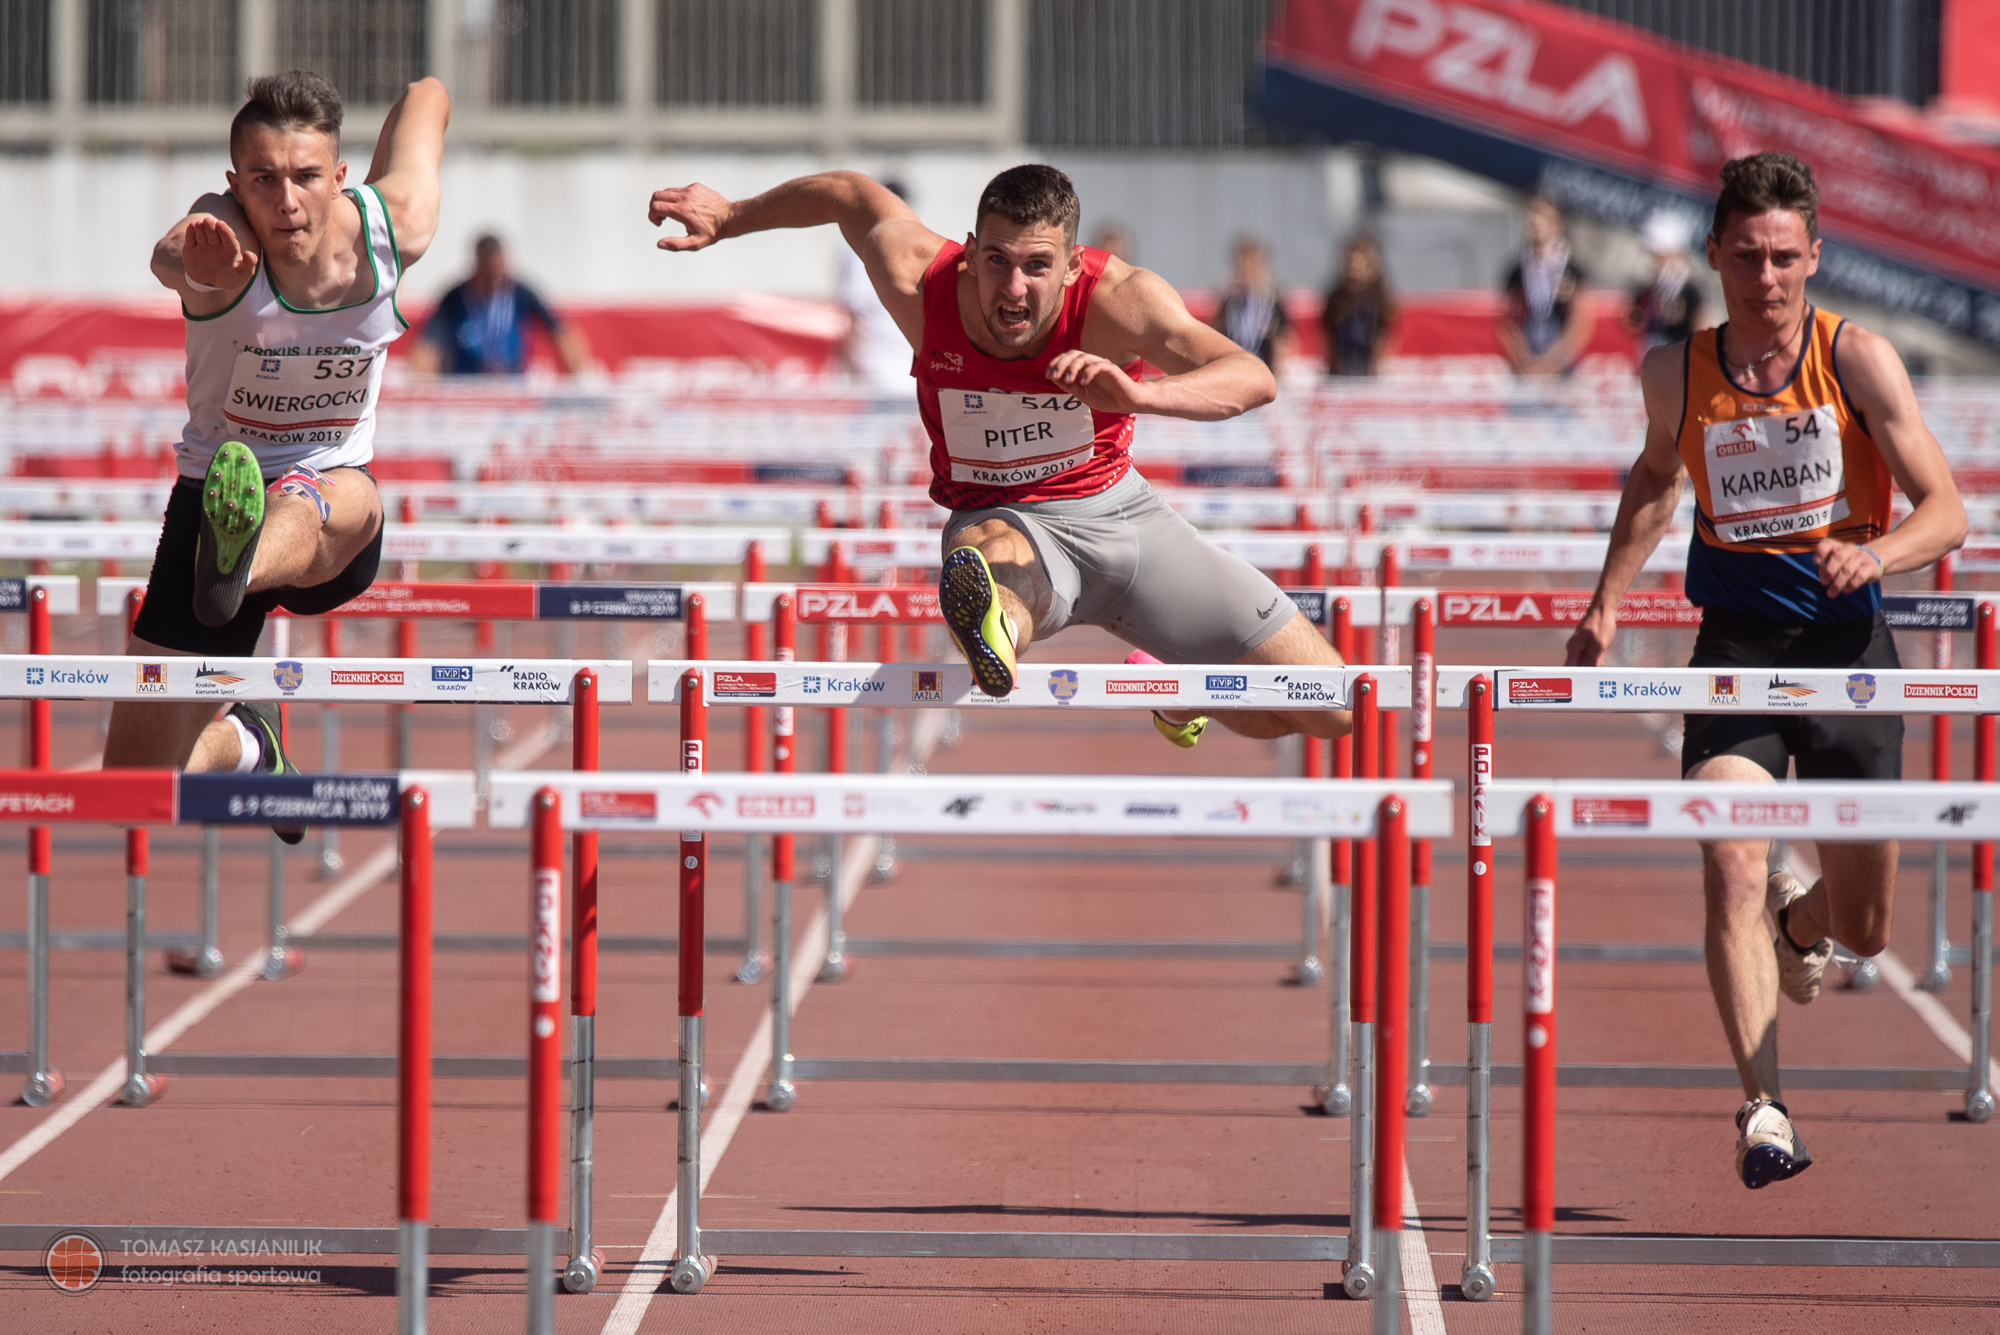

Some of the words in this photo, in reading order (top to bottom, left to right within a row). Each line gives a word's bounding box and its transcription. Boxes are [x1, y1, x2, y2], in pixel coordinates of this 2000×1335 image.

[1349, 0, 1649, 147] PZLA
[313, 356, 374, 380] 537
[232, 387, 367, 412] ŚWIERGOCKI
[1021, 395, 1082, 412] 546
[240, 427, 305, 444] KRAKÓW
[308, 430, 342, 443] 2019
[984, 421, 1054, 448] PITER
[1785, 414, 1821, 444] 54
[1718, 442, 1754, 456] ORLEN
[972, 469, 1037, 483] KRAKÓW
[1041, 459, 1075, 476] 2019
[1721, 459, 1832, 498] KARABAN
[1734, 518, 1794, 538] KRAKÓW
[1798, 510, 1829, 528] 2019
[800, 592, 898, 618] PZLA
[1443, 595, 1544, 622] PZLA
[51, 669, 110, 685] Kraków
[332, 671, 371, 684] DZIENNIK
[371, 671, 403, 684] POLSKI
[436, 668, 470, 680] TVP3
[513, 672, 547, 681] RADIO
[716, 675, 744, 683] PZLA
[138, 684, 165, 693] MZLA
[513, 680, 561, 691] KRAKÓW
[827, 675, 885, 693] Kraków
[1107, 681, 1146, 693] DZIENNIK
[1146, 680, 1178, 694] POLSKI
[1210, 678, 1245, 690] TVP3
[1287, 682, 1322, 691] RADIO
[1512, 681, 1539, 689] PZLA
[1623, 681, 1682, 696] Kraków
[914, 691, 941, 701] MZLA
[1210, 692, 1241, 700] KRAKÓW
[1287, 690, 1336, 701] KRAKÓW
[1905, 685, 1944, 697] DZIENNIK
[1944, 685, 1977, 698] POLSKI
[1710, 696, 1738, 704] MZLA
